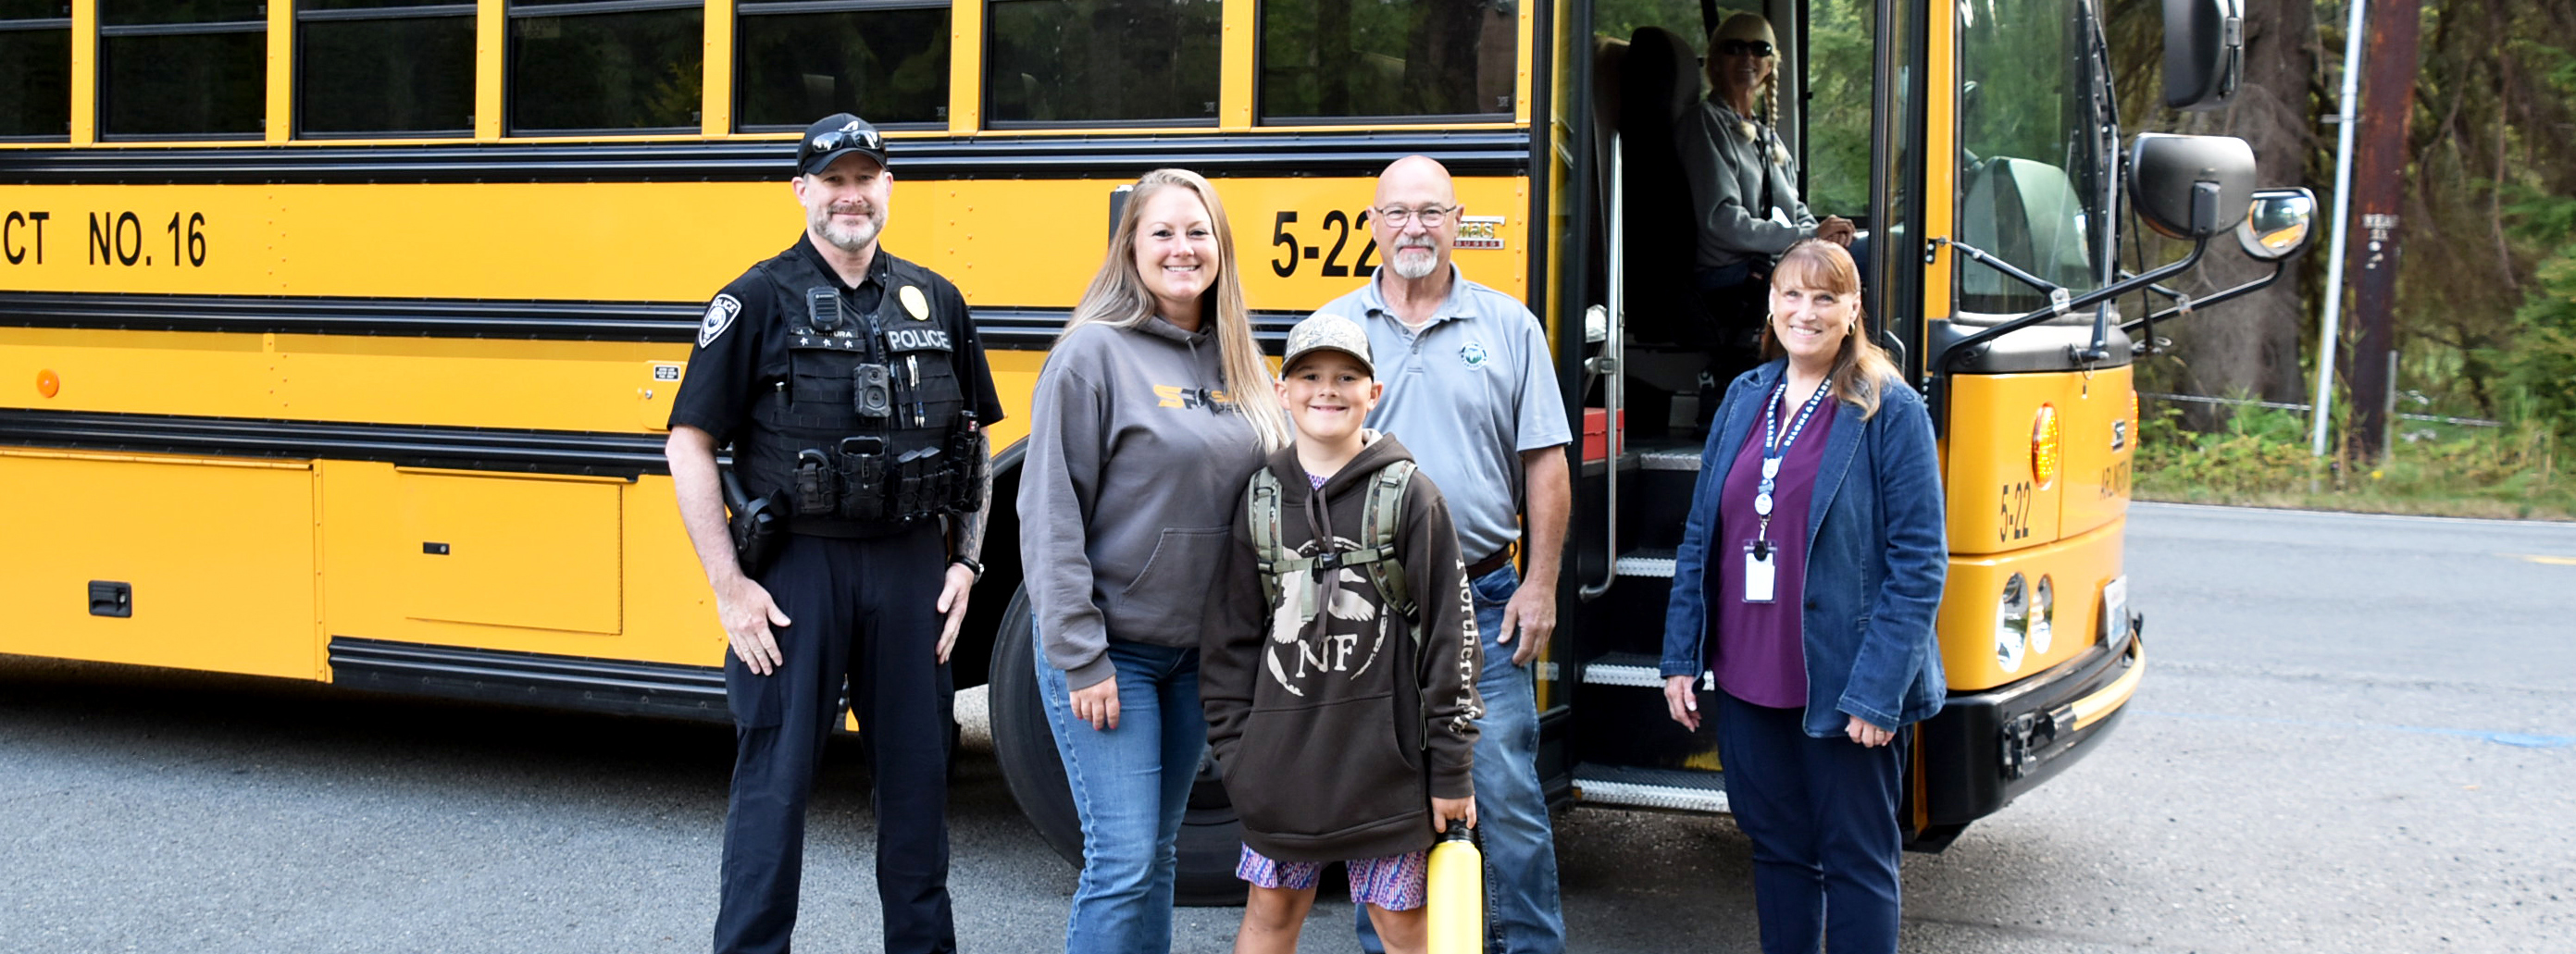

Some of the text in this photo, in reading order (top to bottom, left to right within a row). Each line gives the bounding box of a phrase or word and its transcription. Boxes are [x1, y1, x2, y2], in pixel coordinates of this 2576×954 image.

[4, 211, 206, 267] CT NO. 16
[1271, 210, 1378, 278] 5-22
[808, 328, 852, 338] VURA
[888, 328, 952, 350] POLICE
[1999, 480, 2031, 543] 5-22
[1295, 633, 1358, 679] NF
